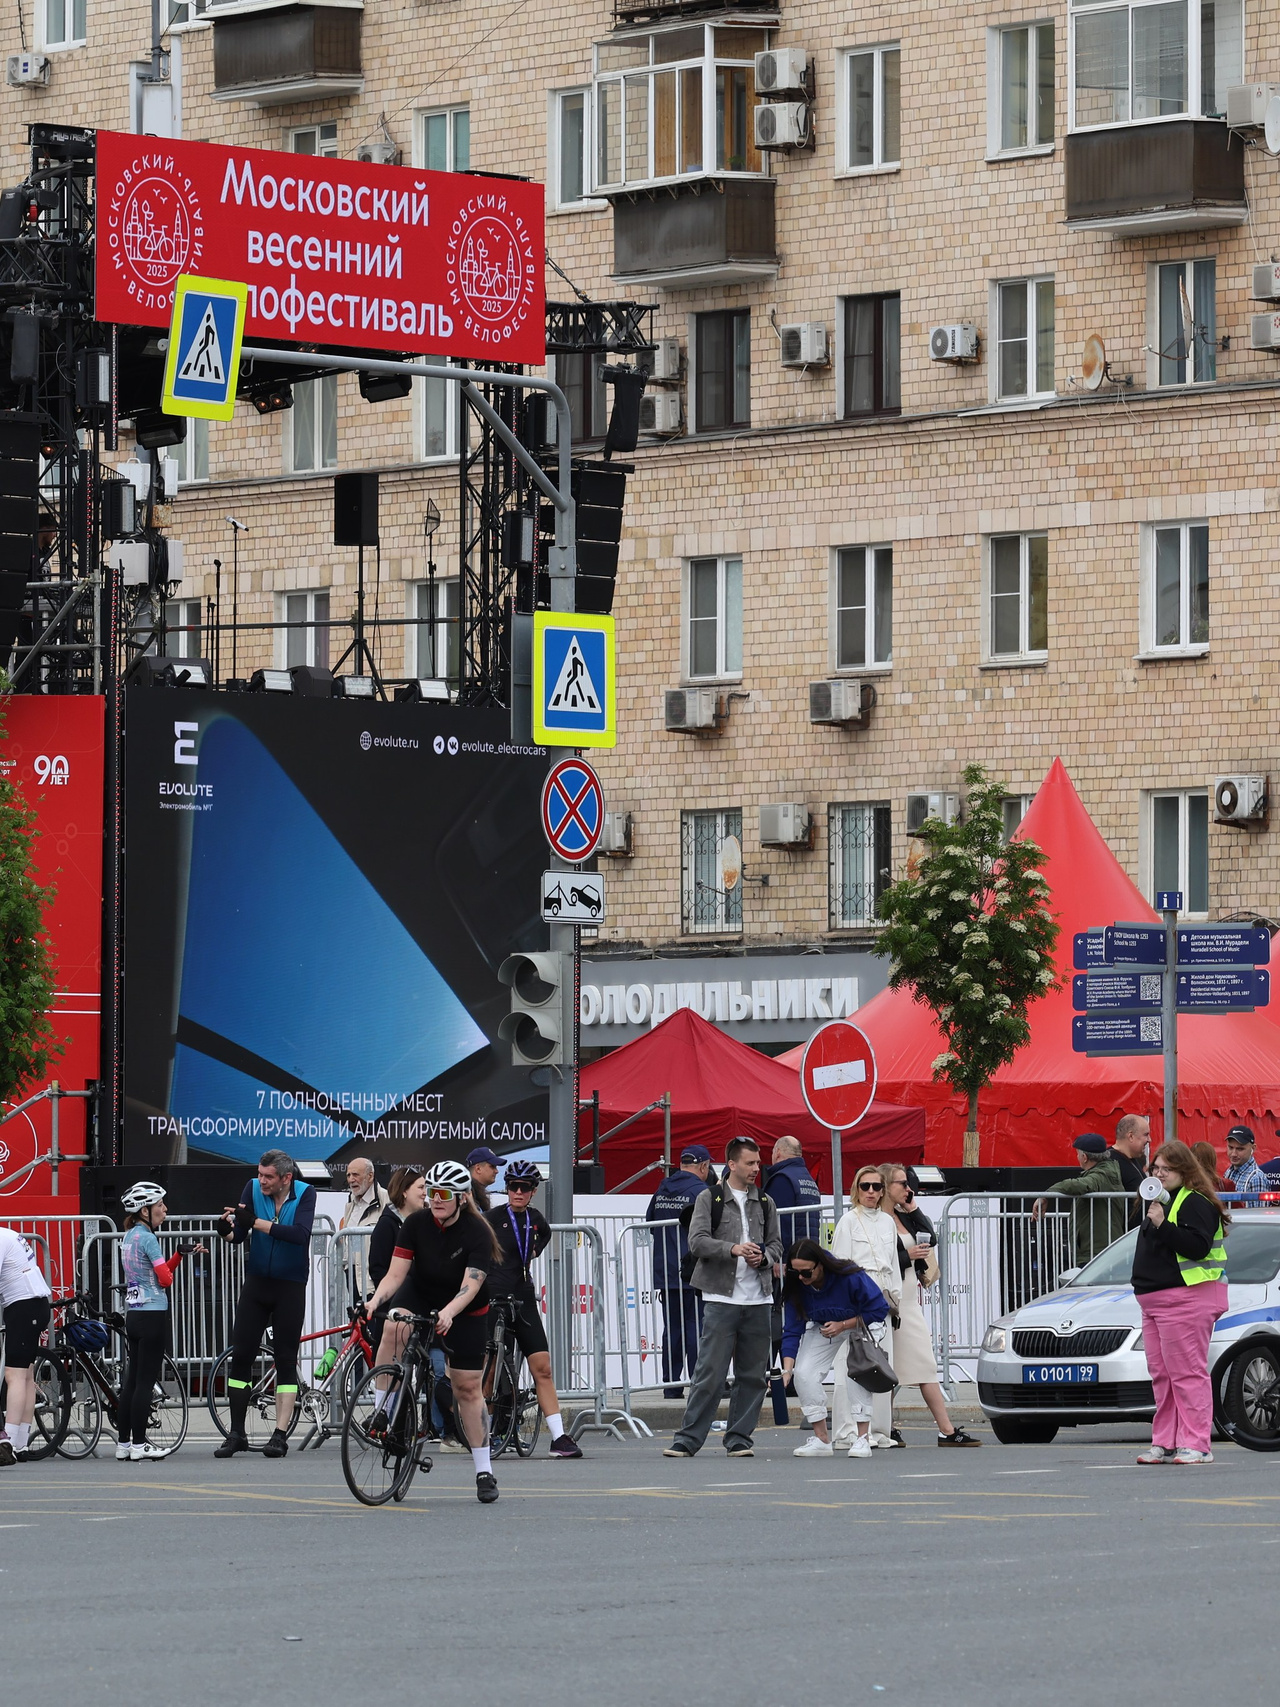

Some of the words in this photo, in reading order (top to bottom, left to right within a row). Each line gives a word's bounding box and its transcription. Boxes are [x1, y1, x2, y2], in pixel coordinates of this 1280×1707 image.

[220, 157, 429, 227] Московский
[108, 154, 174, 270] МОСКОВСКИЙ
[127, 170, 204, 310] ВЕЛОТИВАЛЬ
[446, 194, 508, 304] МОСКОВСКИЙ
[247, 229, 403, 280] весенний
[146, 264, 168, 279] 2025
[464, 216, 535, 344] ВЕЛОФЕСТИВАЛЬ
[246, 273, 454, 338] лофестиваль
[482, 300, 502, 314] 2025
[374, 736, 419, 749] evolute.ru
[461, 741, 547, 756] evolute_electrocars
[50, 774, 70, 785] ЛЕТ
[159, 782, 214, 797] EVOLUTE
[159, 802, 202, 810] Электромобиль
[580, 977, 859, 1029] ОЛОДИЛЬНИКИ
[256, 1090, 266, 1109] 7
[270, 1090, 397, 1114] ПОЛНОЦЕННЫХ
[403, 1094, 444, 1113] МЕСТ
[148, 1115, 334, 1138] ТРАНСФОРМИРУЕМЫЙ
[338, 1119, 350, 1138] И
[354, 1117, 487, 1142] АДАПТИРУЕМЫЙ
[490, 1120, 546, 1141] САЛОН
[1041, 1367, 1072, 1382] 0101
[1080, 1366, 1093, 1376] 99
